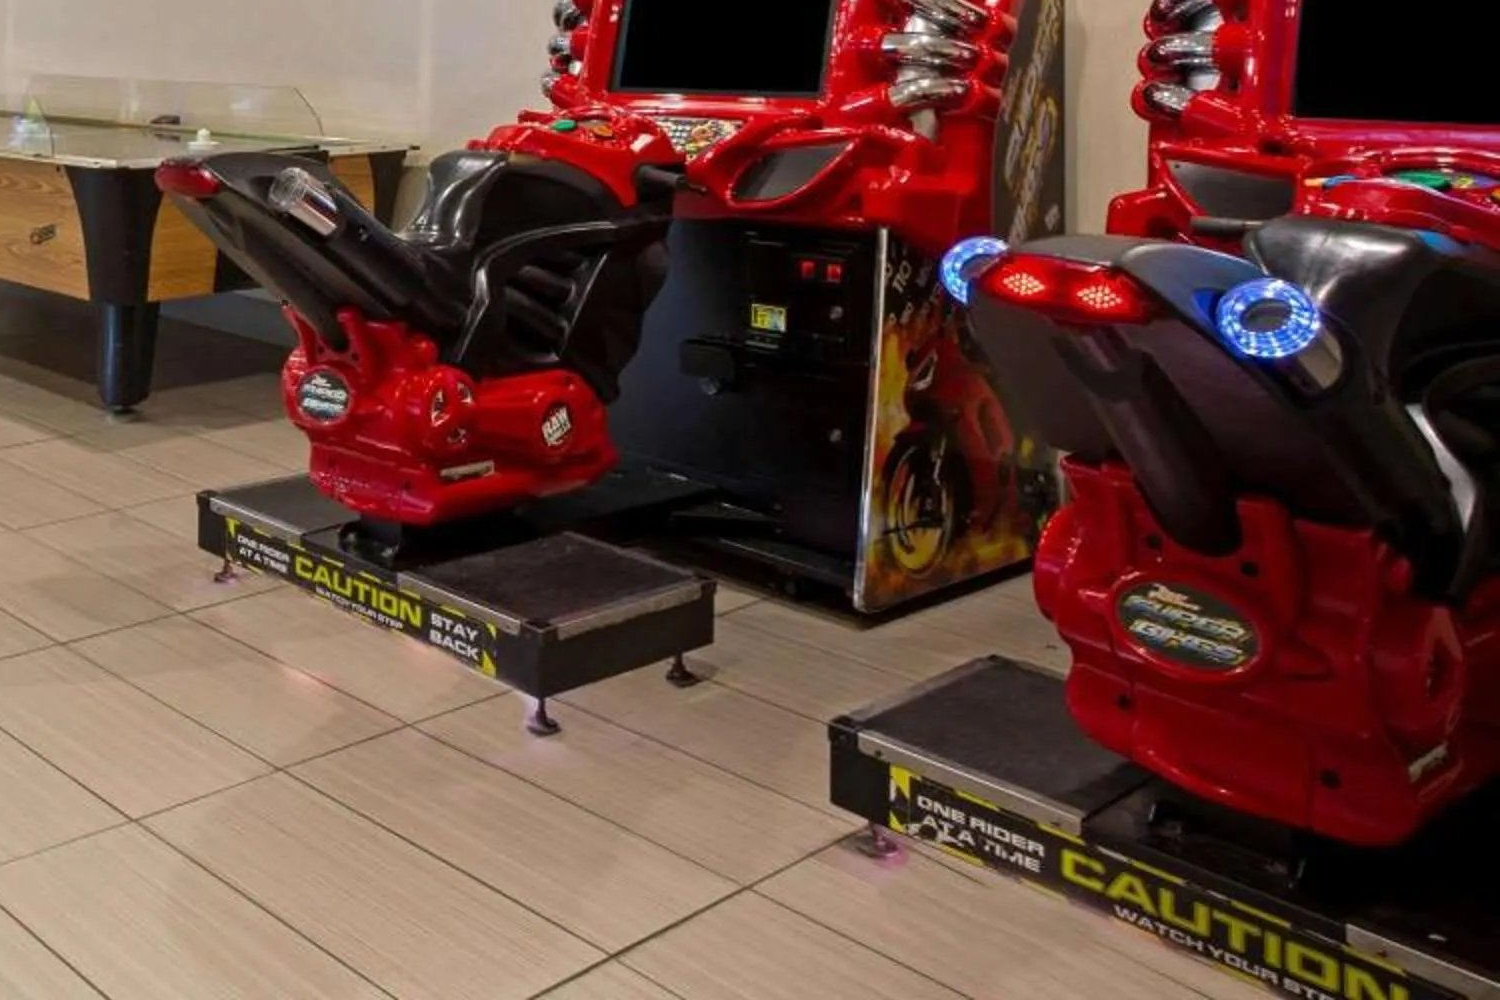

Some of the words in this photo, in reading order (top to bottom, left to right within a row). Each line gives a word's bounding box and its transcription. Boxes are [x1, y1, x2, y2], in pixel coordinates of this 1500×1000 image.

[294, 555, 422, 627] CAUTION
[429, 628, 480, 660] BACK
[430, 612, 479, 641] STAY
[917, 795, 966, 824] ONE
[969, 815, 1045, 857] RIDER
[958, 829, 976, 847] A
[1061, 848, 1409, 1000] CAUTION
[1113, 904, 1204, 954] WATCH
[1205, 942, 1279, 985] YOUR
